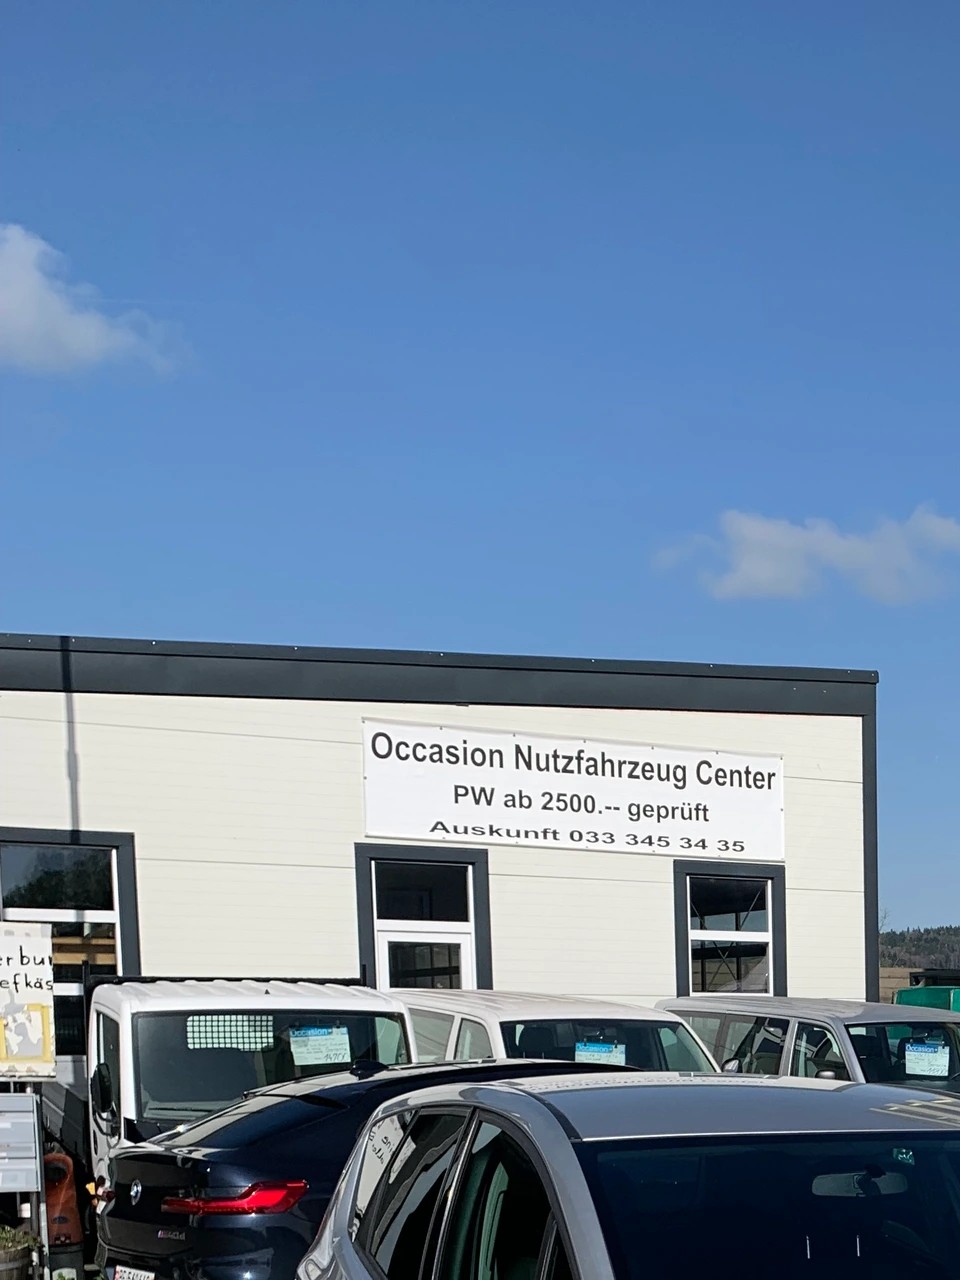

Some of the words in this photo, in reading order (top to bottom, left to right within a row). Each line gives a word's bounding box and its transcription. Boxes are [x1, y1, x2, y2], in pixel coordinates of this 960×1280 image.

[371, 732, 504, 769] Occasion
[514, 744, 687, 790] Nutzfahrzeug
[696, 760, 777, 790] Center
[453, 785, 496, 806] PW
[503, 790, 533, 810] ab
[627, 801, 710, 823] geprüft
[429, 820, 561, 842] Auskunft
[568, 829, 616, 845] 033
[625, 833, 671, 849] 345
[679, 837, 709, 851] 34
[717, 839, 745, 853] 35
